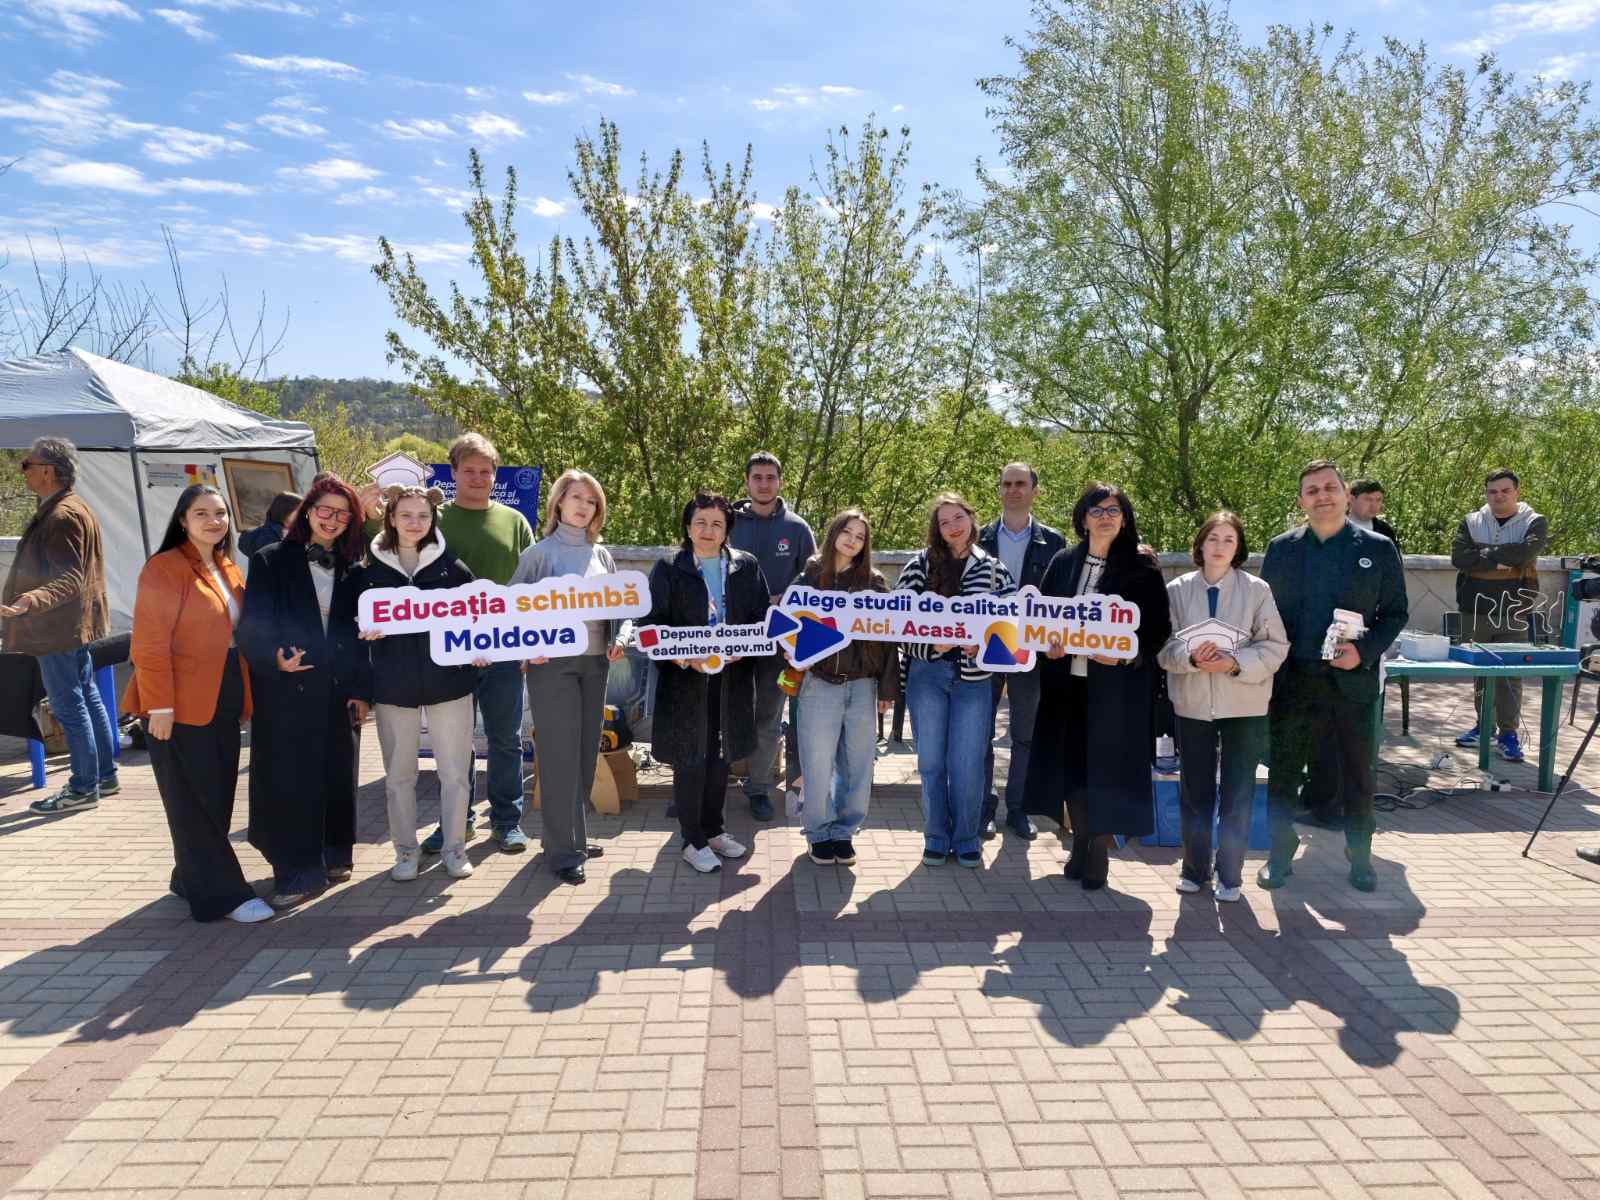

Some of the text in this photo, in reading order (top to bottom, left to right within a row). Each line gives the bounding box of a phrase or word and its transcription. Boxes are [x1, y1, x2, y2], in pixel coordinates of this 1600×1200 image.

[373, 583, 640, 624] Educația schimbă
[786, 591, 1019, 617] Alege studii de calitat
[1025, 593, 1133, 627] Învață în
[444, 625, 576, 652] Moldova
[660, 626, 764, 641] Depune dosarul
[850, 618, 972, 639] Aici. Acasă.
[1024, 624, 1132, 651] Moldova
[652, 641, 774, 656] eadmitere.gov.md
